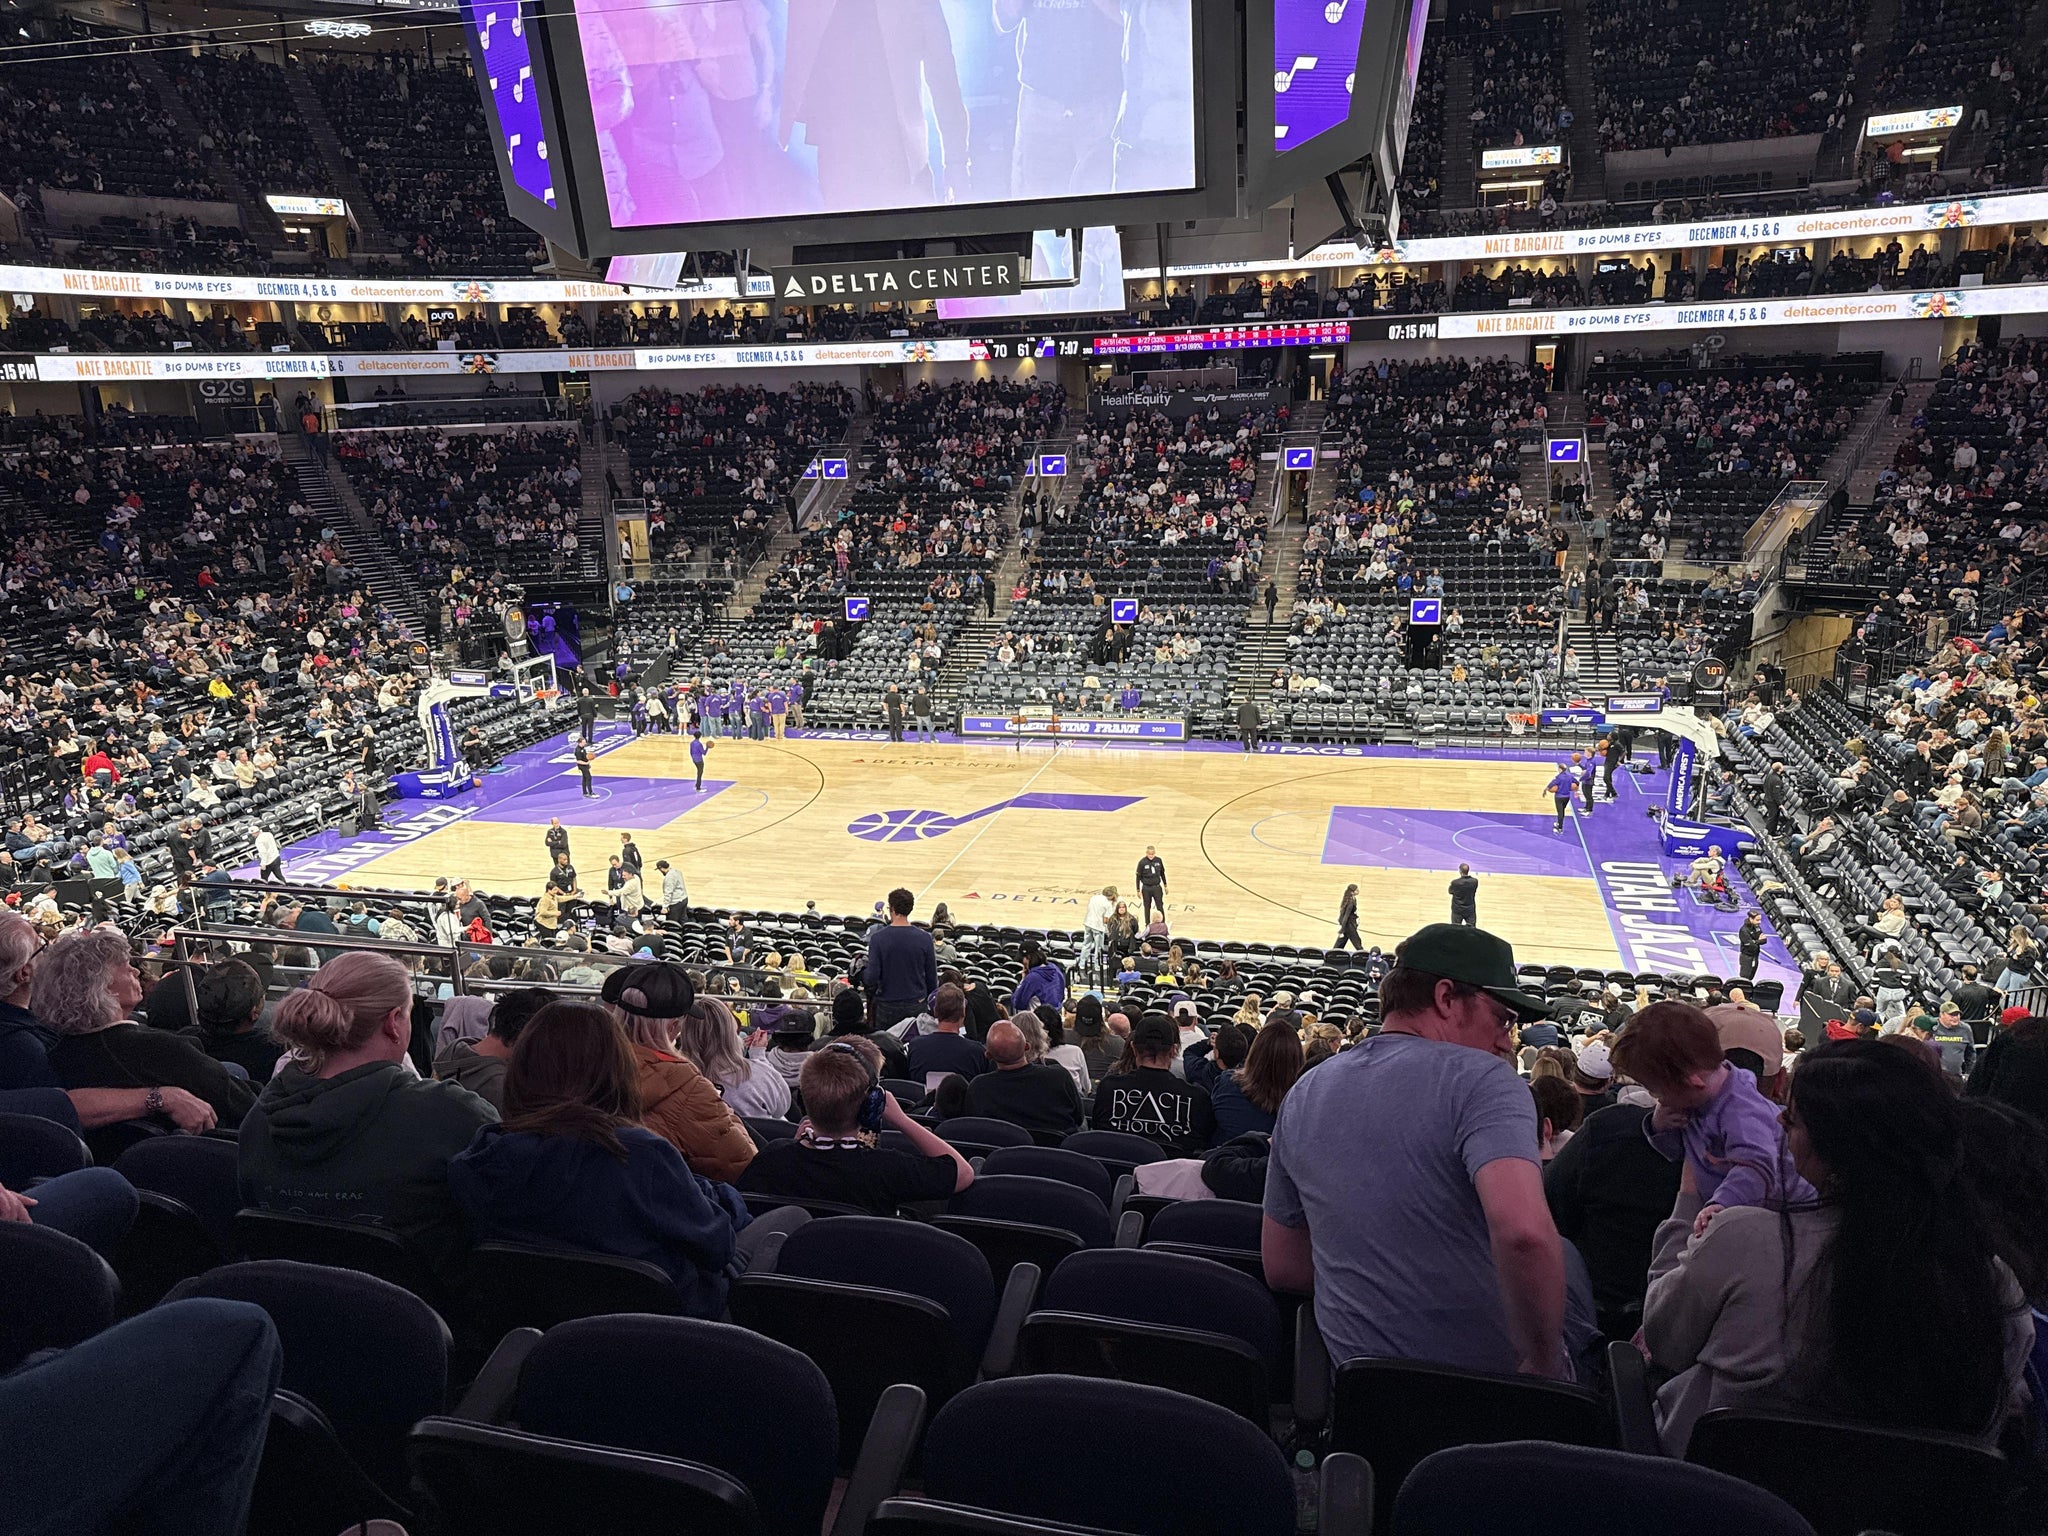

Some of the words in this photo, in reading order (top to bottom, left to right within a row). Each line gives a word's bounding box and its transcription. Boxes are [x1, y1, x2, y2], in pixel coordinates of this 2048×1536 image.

[1485, 236, 1512, 253] NATE
[1514, 235, 1564, 252] BARGATZE
[1578, 236, 1596, 246] BIG
[1599, 234, 1630, 245] DUMB
[1634, 232, 1661, 242] EYES
[1689, 226, 1737, 242] DECEMBER
[1762, 223, 1770, 236] &
[1773, 223, 1780, 236] 6
[1797, 214, 1912, 233] deltacenter.com
[63, 274, 90, 290] NATE
[92, 275, 142, 292] BARGATZE
[155, 280, 173, 291] BIG
[175, 281, 204, 292] DUMB
[206, 282, 232, 292] EYES
[258, 282, 300, 296] DECEMBER
[321, 285, 329, 296] &
[331, 285, 337, 296] 6
[350, 286, 444, 298] deltacenter.com
[810, 272, 898, 294] DELTA
[908, 265, 1010, 289] CENTER
[564, 284, 587, 298] NATE
[1477, 318, 1501, 333] NATE
[1505, 316, 1555, 331] BARGATZE
[1568, 317, 1586, 326] BIG
[1589, 315, 1620, 325] DUMB
[1624, 313, 1650, 324] EYES
[1678, 308, 1724, 324] DECEMBER
[1749, 307, 1758, 320] &
[1760, 307, 1767, 320] 6
[1784, 303, 1896, 318] deltacenter.com
[1388, 325, 1416, 340] 07:15
[1419, 323, 1436, 338] PM
[568, 354, 592, 368] NATE
[594, 352, 636, 366] BARGATZE
[648, 354, 663, 363] BIG
[666, 354, 691, 363] DUMB
[694, 353, 716, 362] EYES
[737, 351, 773, 363] DECEMBER
[791, 351, 797, 362] &
[798, 350, 804, 361] 6
[815, 348, 894, 360] deltacenter.com
[993, 344, 1007, 358] 70
[1017, 343, 1029, 357] 61
[1059, 341, 1078, 355] 7:07
[18, 363, 37, 380] PM
[76, 360, 102, 376] NATE
[104, 360, 152, 376] BARGATZE
[165, 362, 182, 372] BIG
[185, 362, 214, 372] DUMB
[216, 362, 241, 372] EYES
[266, 360, 308, 372] DECEMBER
[329, 360, 336, 372] &
[338, 360, 344, 372] 6
[358, 359, 450, 370] deltacenter.com
[199, 380, 246, 396] G2G
[1101, 393, 1171, 406] HealthEquity
[816, 731, 890, 740] PACS
[1094, 723, 1141, 734] FRANK
[1280, 746, 1362, 756] PACS
[1680, 753, 1689, 777] FIRST
[1675, 778, 1686, 811] AMERICA
[287, 841, 392, 884] UTAH
[380, 804, 479, 842] JAZZ
[1601, 861, 1680, 912] UTAH
[992, 893, 1078, 905] DELTA
[1620, 914, 1710, 974] JAZZ
[1112, 1089, 1192, 1125] BEACH
[1117, 1120, 1183, 1142] HOUSE
